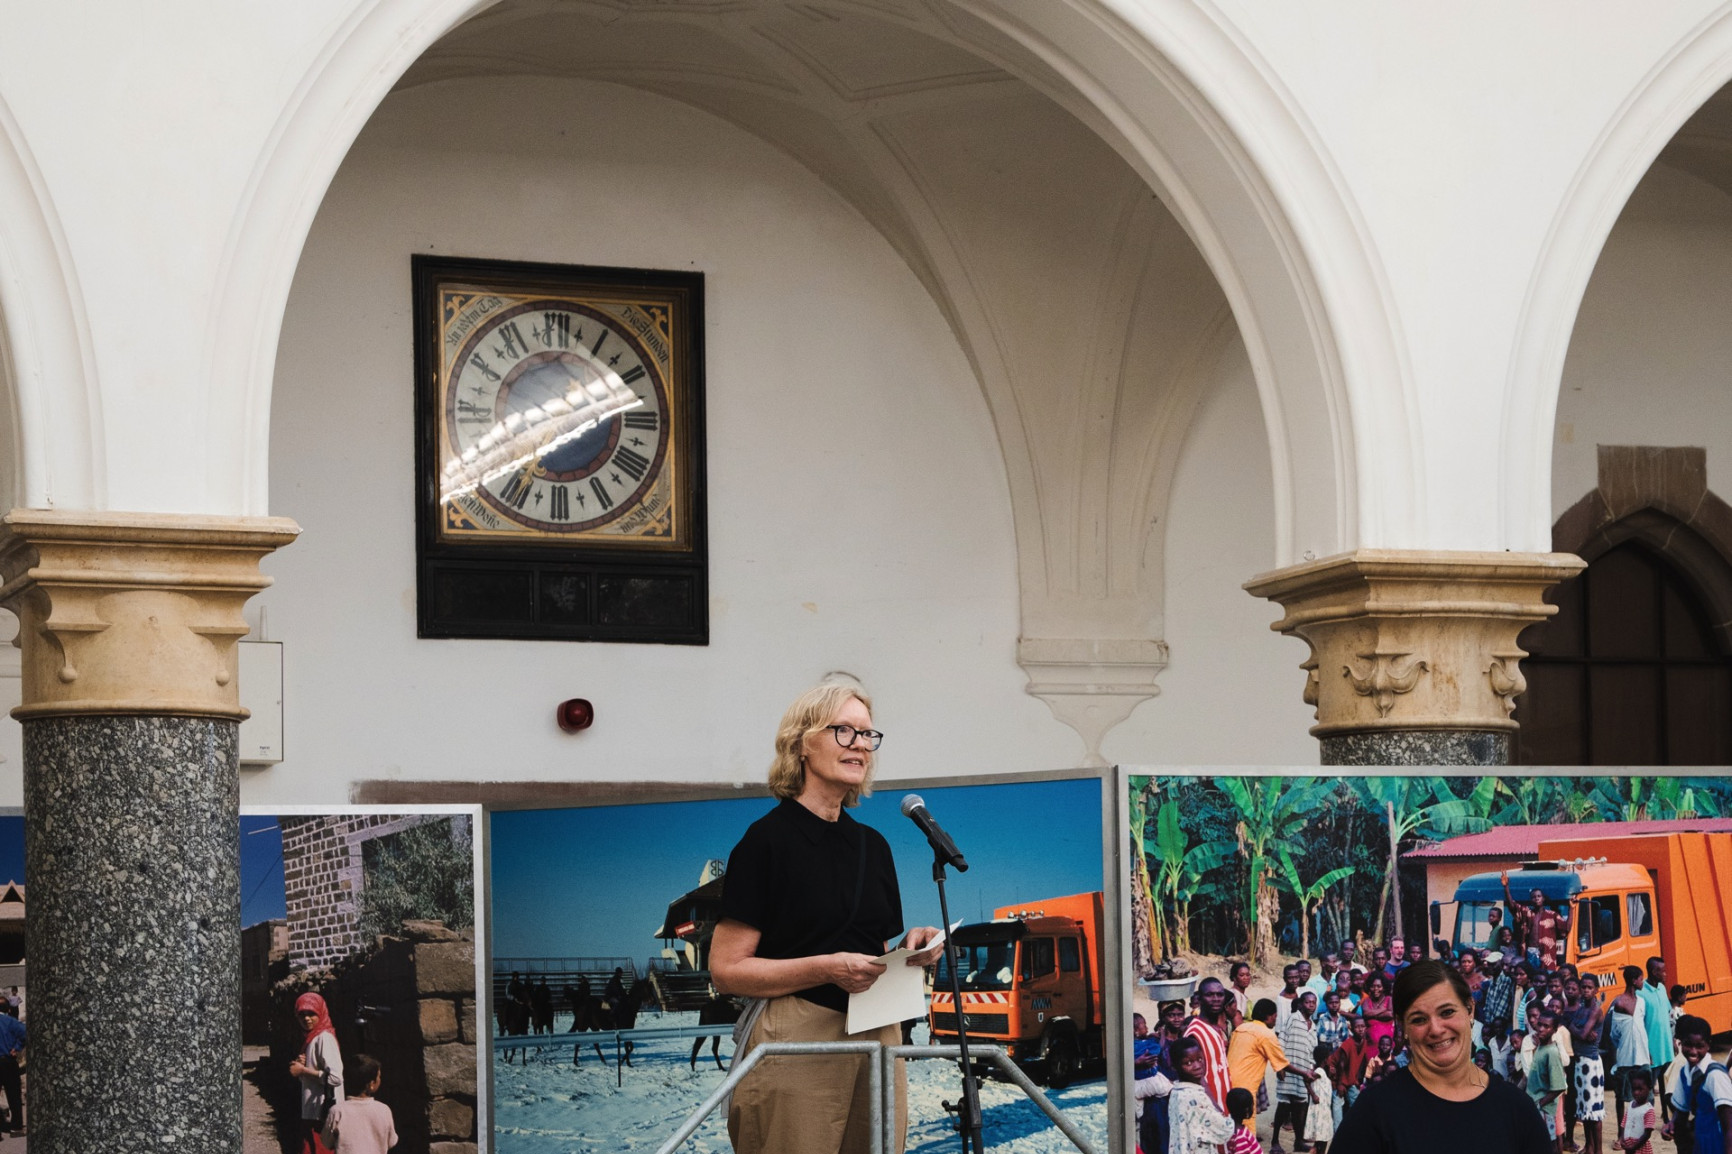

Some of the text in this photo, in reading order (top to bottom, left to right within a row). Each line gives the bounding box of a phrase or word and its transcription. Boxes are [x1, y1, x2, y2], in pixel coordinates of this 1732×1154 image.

[476, 296, 503, 314] Tag
[498, 321, 530, 360] XI
[541, 311, 571, 349] XII
[621, 306, 669, 363] Die Stunden
[590, 328, 609, 358] I
[470, 352, 501, 382] X
[620, 364, 646, 385] II
[624, 411, 658, 432] III
[1598, 972, 1617, 987] WM
[1684, 982, 1705, 993] AUN
